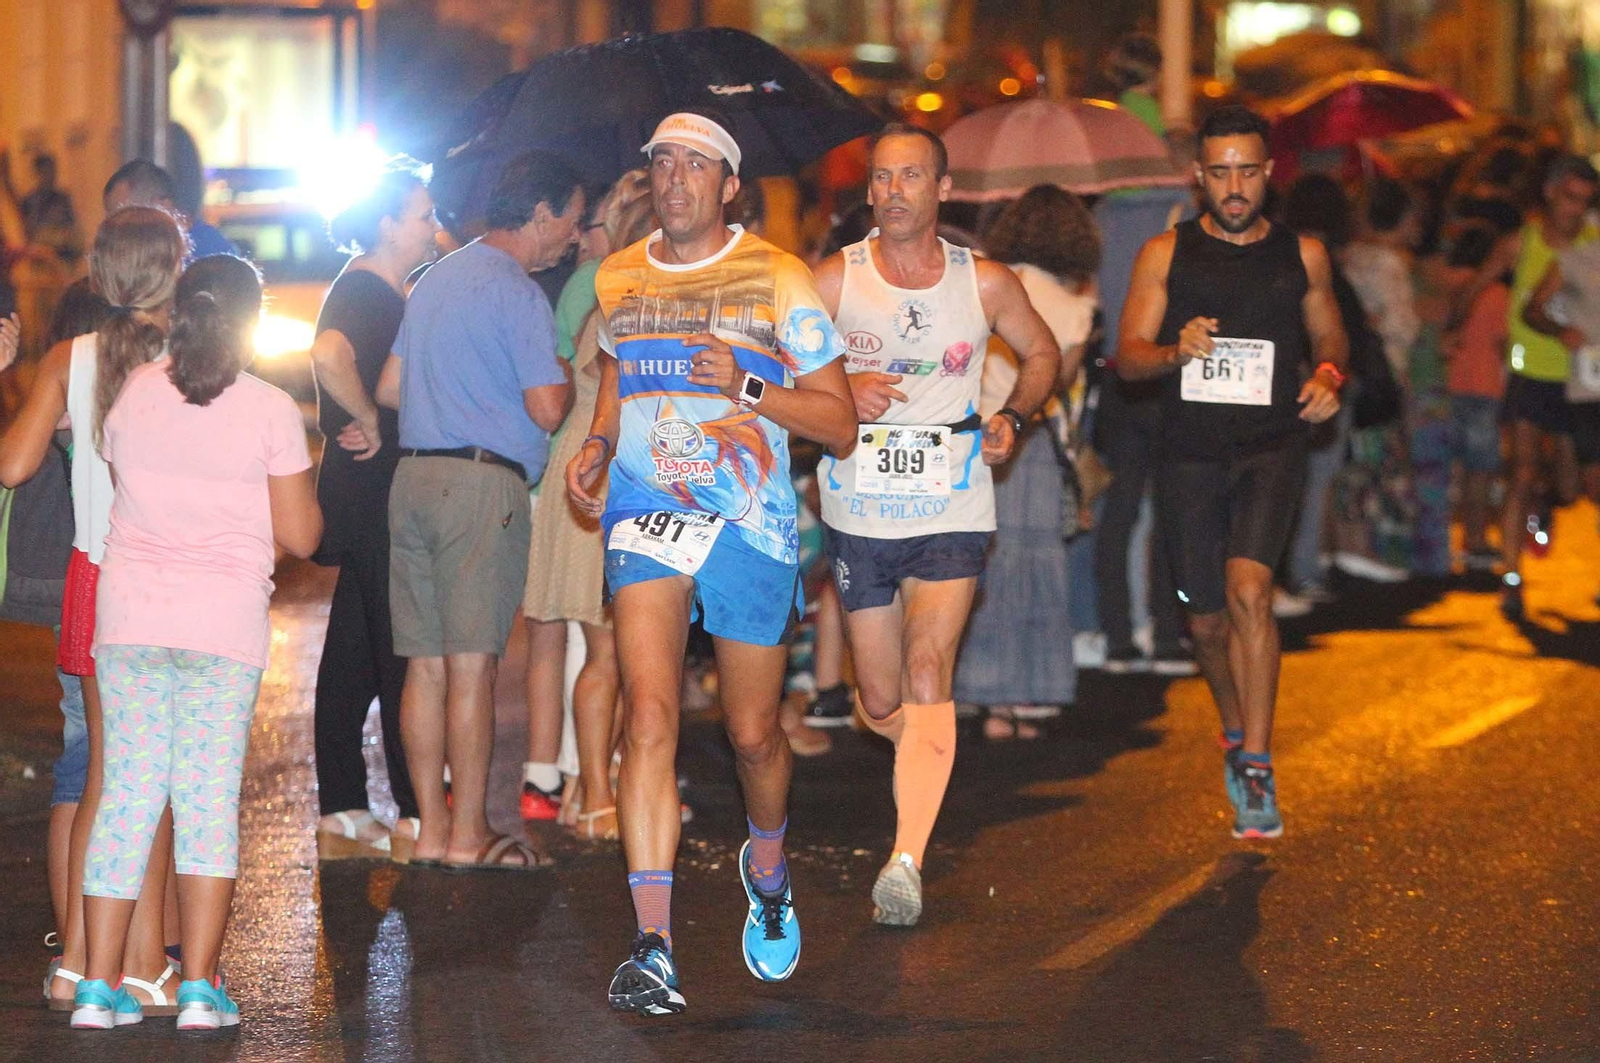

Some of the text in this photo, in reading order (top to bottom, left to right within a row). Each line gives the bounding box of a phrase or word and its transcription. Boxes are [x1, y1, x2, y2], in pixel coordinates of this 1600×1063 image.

[848, 335, 875, 351] KIA
[639, 359, 694, 376] HUE
[654, 458, 713, 474] TOYOTA
[877, 448, 925, 475] 309
[633, 510, 687, 543] 491
